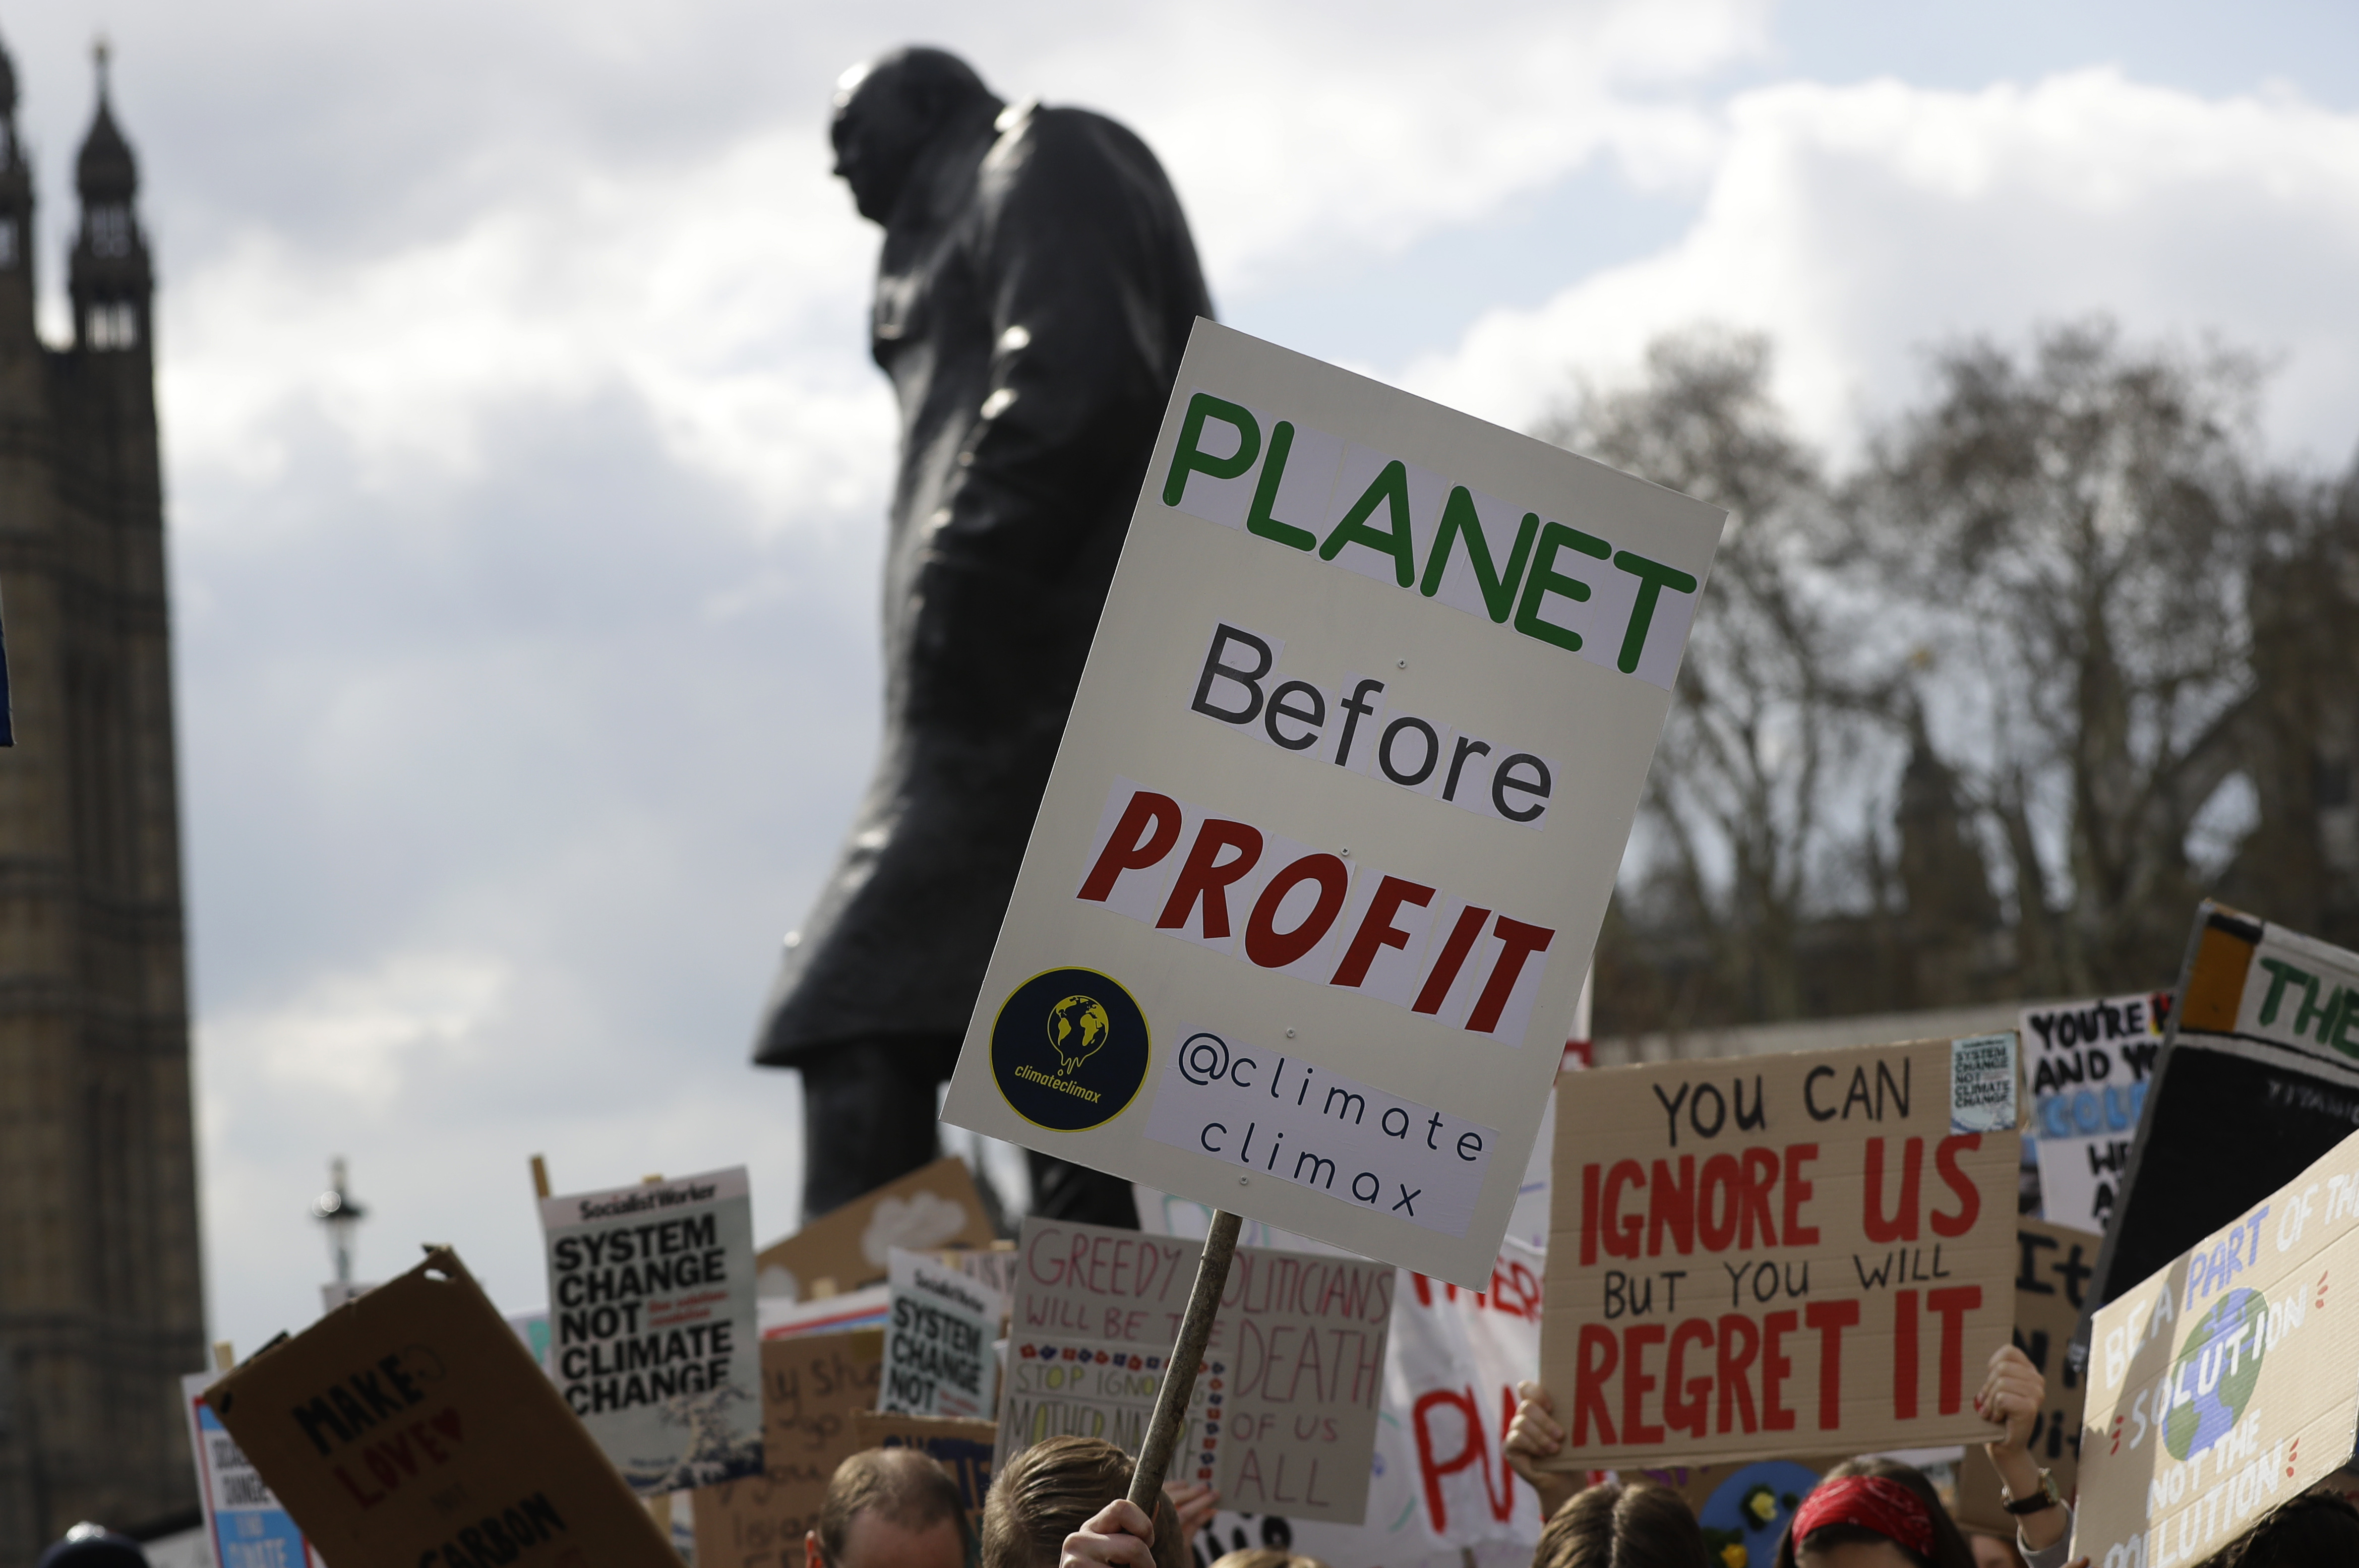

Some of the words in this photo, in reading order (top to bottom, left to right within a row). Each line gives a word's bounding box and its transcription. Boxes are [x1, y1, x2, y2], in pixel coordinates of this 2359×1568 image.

[1162, 392, 1698, 674] PLANET
[1190, 622, 1552, 823] Before
[1076, 790, 1556, 1034] PROFIT
[1014, 1063, 1102, 1104] climateclimax
[1178, 1032, 1483, 1162] @climate
[1652, 1074, 1765, 1147] YOU
[1804, 1056, 1910, 1122] CAN
[2035, 1048, 2110, 1094] AND
[1200, 1121, 1422, 1218] climax
[1579, 1143, 1820, 1267] IGNORE
[1862, 1134, 1982, 1243] US
[555, 1212, 716, 1272] SYSTEM
[558, 1247, 726, 1308] CHANGE
[1027, 1228, 1183, 1302] GREEDY
[1219, 1247, 1394, 1325] OLITICIANS
[1604, 1271, 1687, 1319] BUT
[1724, 1260, 1809, 1307] YOU
[1852, 1243, 1950, 1291] WILL
[560, 1300, 642, 1345] NOT
[895, 1296, 983, 1357] SYSTEM
[2104, 1300, 2147, 1390] BE
[2151, 1282, 2174, 1339] A
[2186, 1205, 2270, 1312] PART
[2276, 1183, 2319, 1252] OF
[560, 1319, 735, 1381] CLIMATE
[564, 1357, 732, 1416] CHANGE
[887, 1367, 935, 1411] NOT
[893, 1333, 982, 1397] CHANGE
[1015, 1362, 1084, 1394] STOP
[1095, 1368, 1206, 1407] IGNOG
[1025, 1293, 1090, 1332] WILL
[1104, 1307, 1150, 1342] BE
[1166, 1312, 1227, 1349] TE
[1233, 1317, 1383, 1409] DEATH
[1571, 1299, 1859, 1449] REGRET
[1893, 1285, 1982, 1420] IT
[2129, 1283, 2308, 1450] SOLUTION
[291, 1353, 425, 1457] MAKE
[1230, 1413, 1276, 1442] OF
[1294, 1416, 1339, 1442] US
[334, 1419, 451, 1510] LOVE
[1235, 1448, 1330, 1507] ALL
[2146, 1446, 2211, 1520] NOT
[2214, 1408, 2261, 1475] THE
[418, 1490, 569, 1568] CARBON
